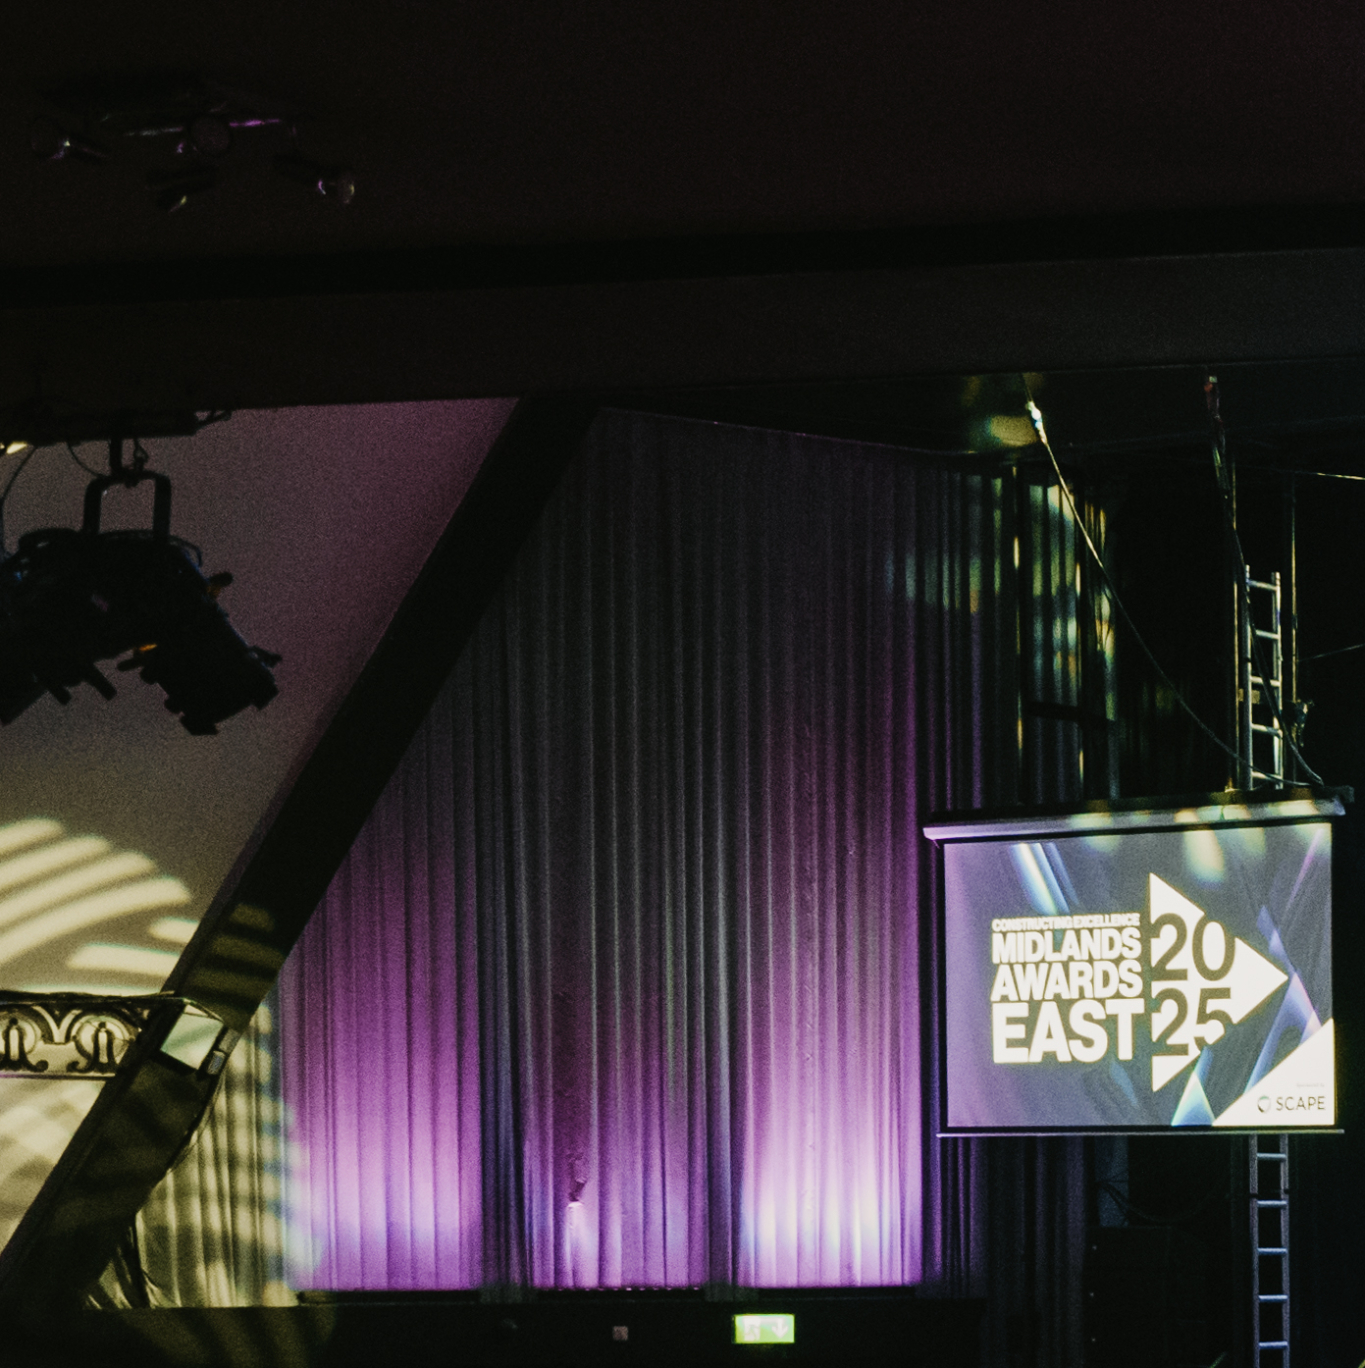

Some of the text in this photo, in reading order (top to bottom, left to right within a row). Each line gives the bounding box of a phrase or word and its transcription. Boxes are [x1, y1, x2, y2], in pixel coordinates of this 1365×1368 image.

[992, 913, 1140, 932] CONSTRUCTING EXCELLENCE
[992, 927, 1142, 964] MIDLANDS
[1151, 912, 1235, 981] 20
[990, 959, 1143, 1001] AWARDS
[992, 998, 1145, 1063] EAST
[1151, 987, 1234, 1057] 25
[1276, 1095, 1326, 1111] SCAPE
